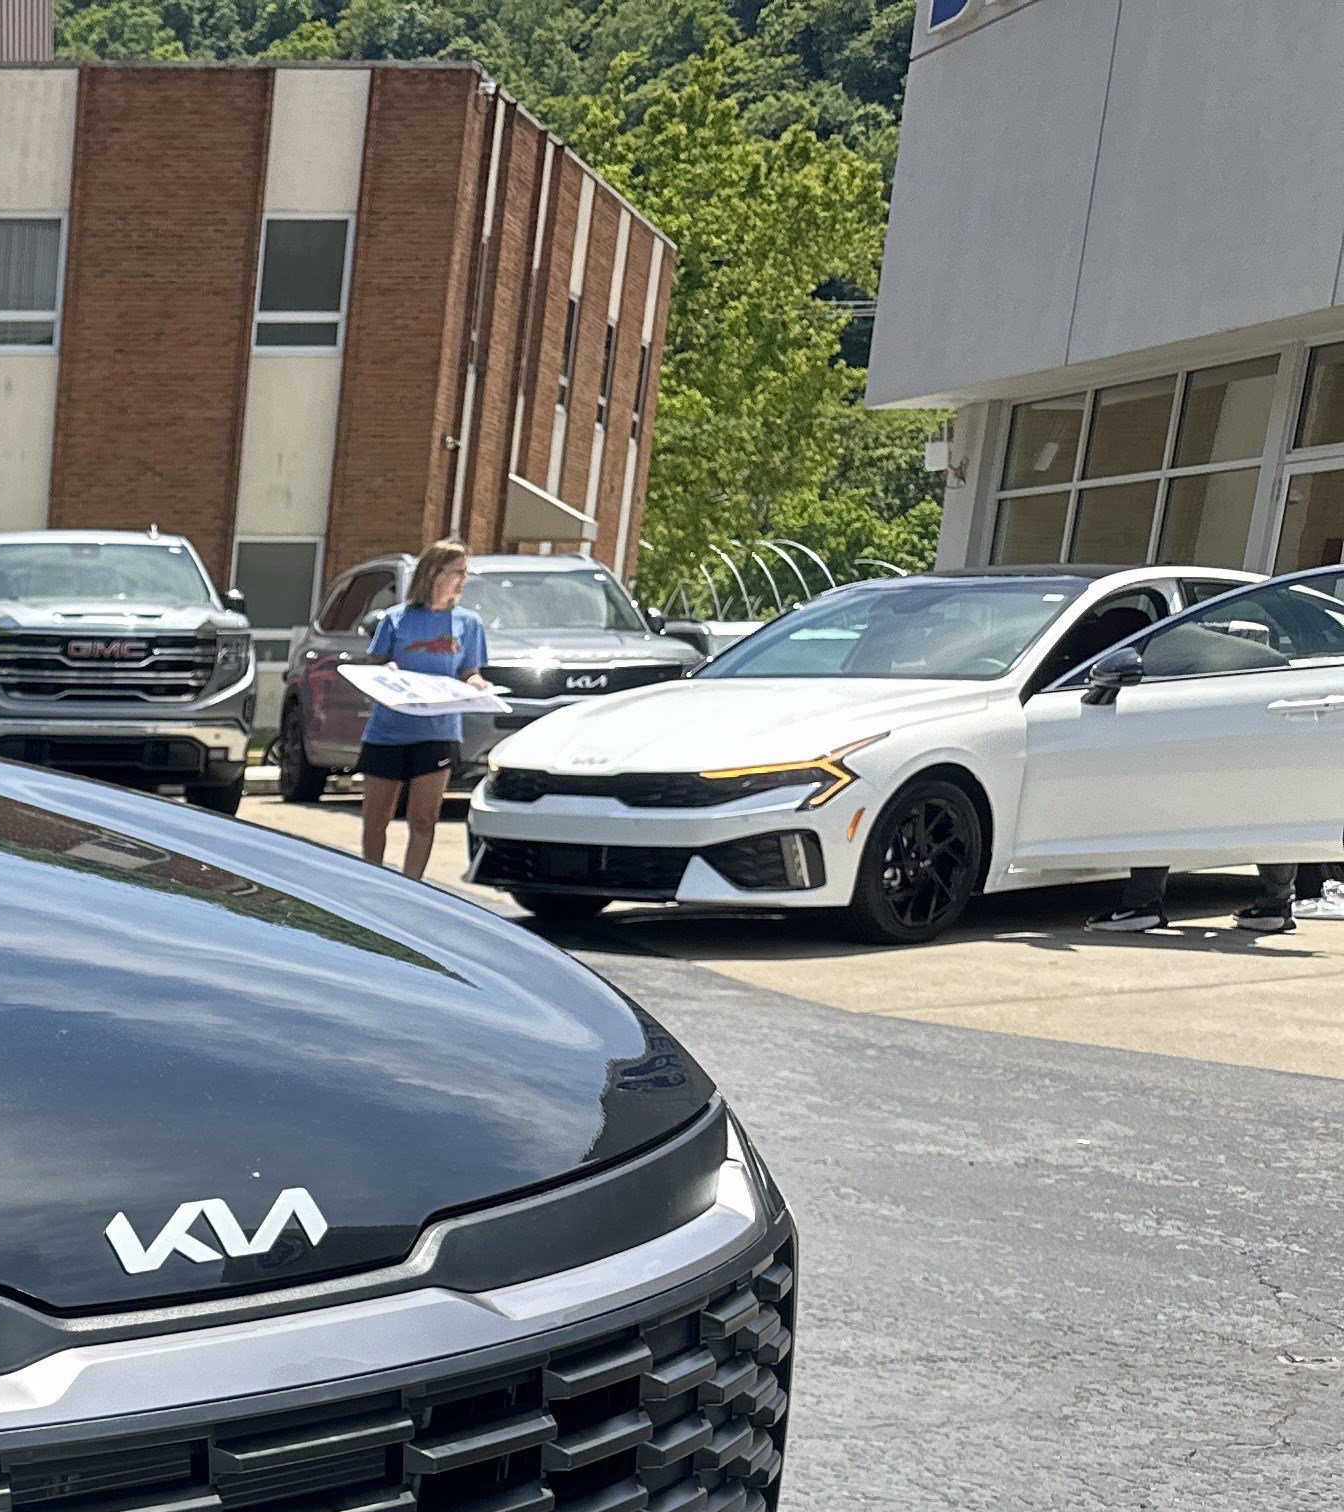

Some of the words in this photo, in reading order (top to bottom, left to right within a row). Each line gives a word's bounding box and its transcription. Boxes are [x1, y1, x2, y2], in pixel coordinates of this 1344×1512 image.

[67, 639, 149, 659] GMC
[565, 674, 608, 689] KIA
[103, 1186, 328, 1276] KIA
